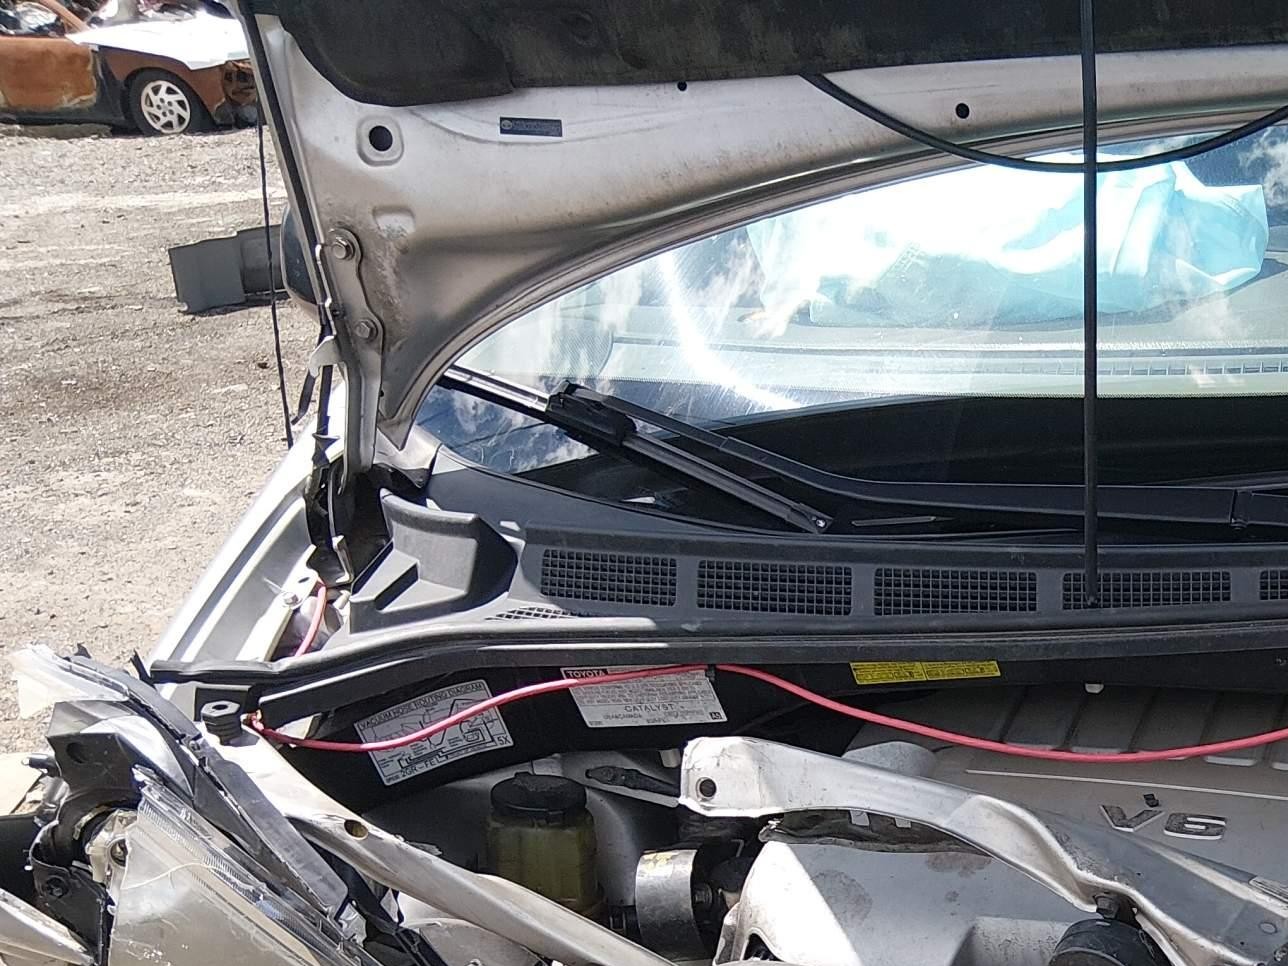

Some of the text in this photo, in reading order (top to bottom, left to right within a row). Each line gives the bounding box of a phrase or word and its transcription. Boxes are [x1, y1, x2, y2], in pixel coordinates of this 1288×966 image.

[360, 682, 483, 730] VACUUM HOSE ROUTING DIAGRAM
[624, 703, 675, 712] CATALYST
[498, 734, 511, 746] 5X
[400, 758, 436, 777] 2GR-FE
[1099, 803, 1228, 840] V6
